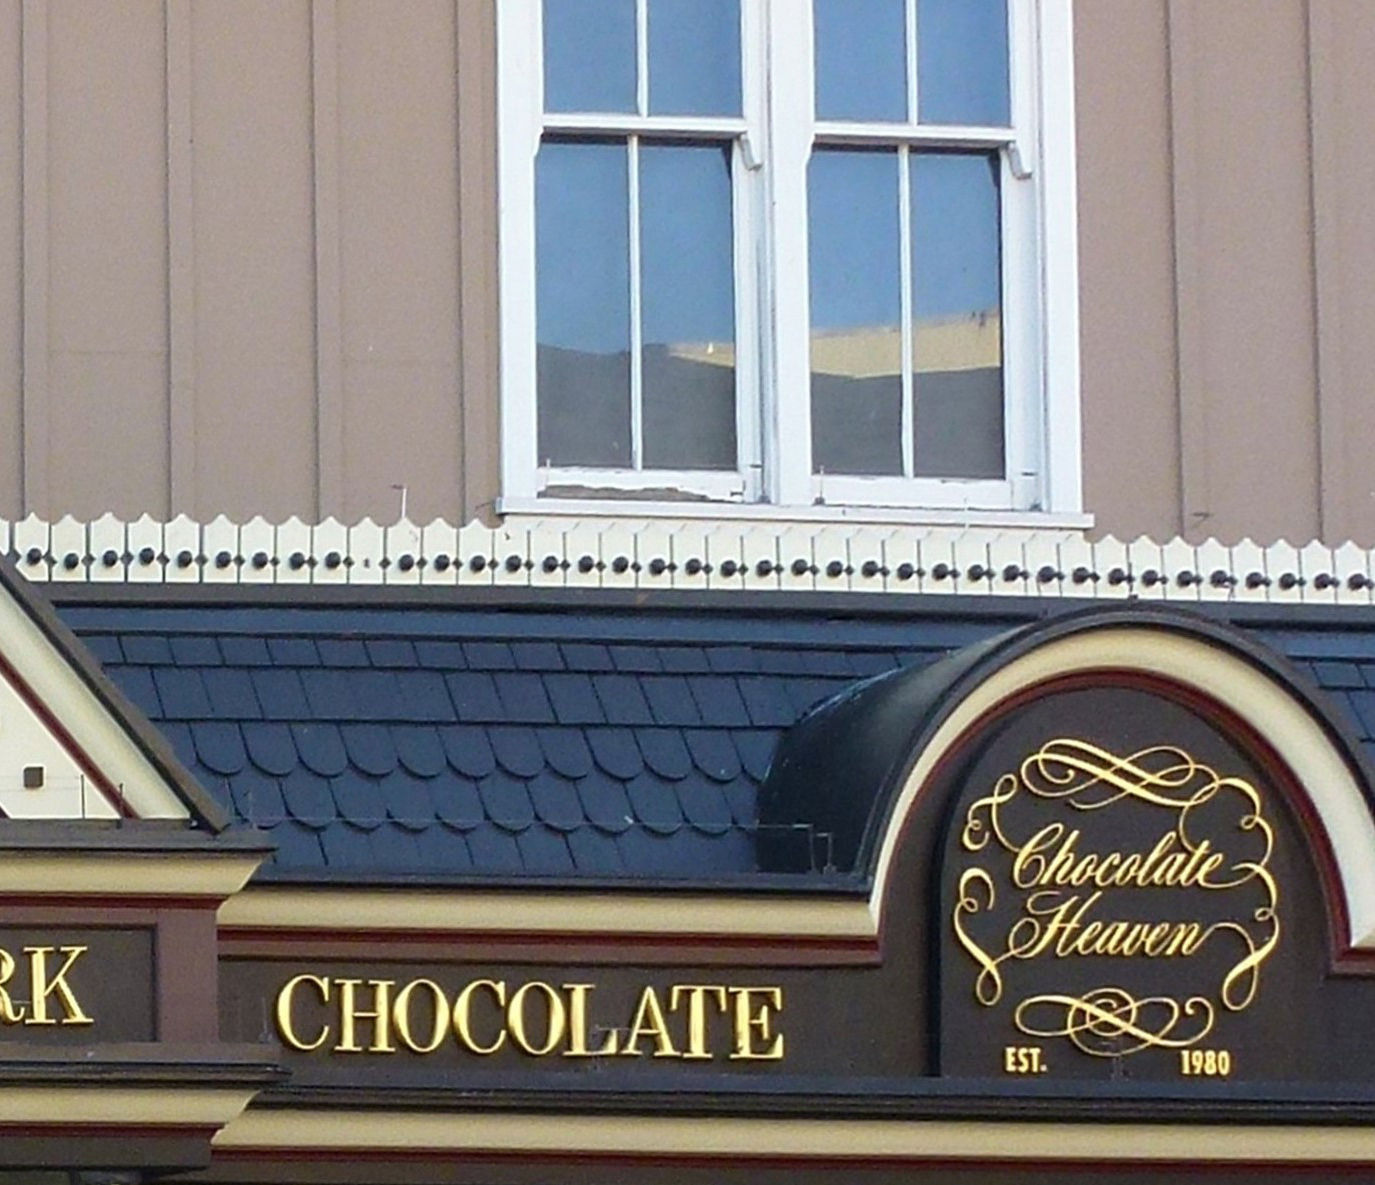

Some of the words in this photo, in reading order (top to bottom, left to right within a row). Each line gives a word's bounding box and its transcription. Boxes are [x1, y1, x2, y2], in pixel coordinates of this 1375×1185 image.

[1012, 823, 1227, 889] Chocolate
[1009, 890, 1211, 958] Heaven
[277, 974, 784, 1060] CHOCOLATE
[1005, 1047, 1047, 1074] EST.
[1181, 1050, 1231, 1076] 1980
